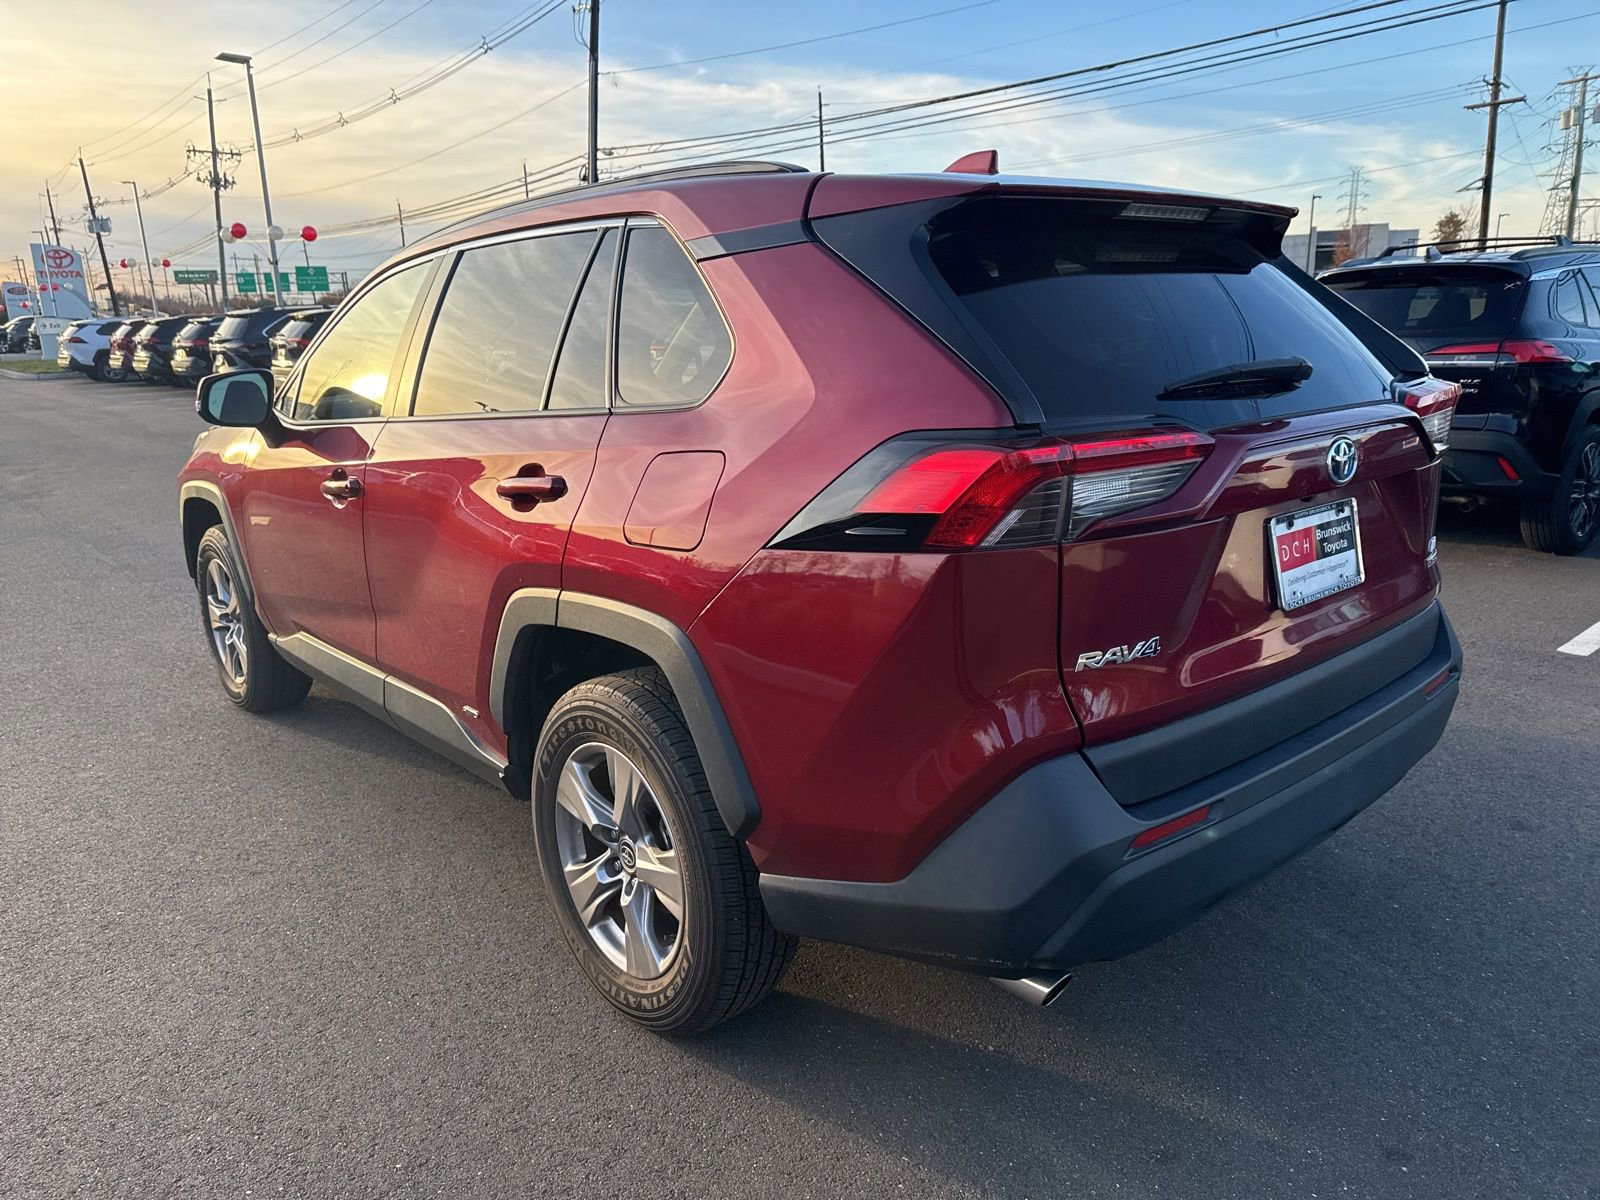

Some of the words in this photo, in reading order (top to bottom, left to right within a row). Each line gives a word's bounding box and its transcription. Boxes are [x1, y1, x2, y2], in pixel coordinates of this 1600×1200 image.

[38, 270, 83, 279] TOYOTA
[1315, 520, 1352, 540] Brunswick
[1281, 537, 1311, 562] DCH
[1322, 538, 1348, 554] Toyota
[1305, 587, 1339, 603] BRUNSWICK
[1074, 635, 1162, 673] RAV4
